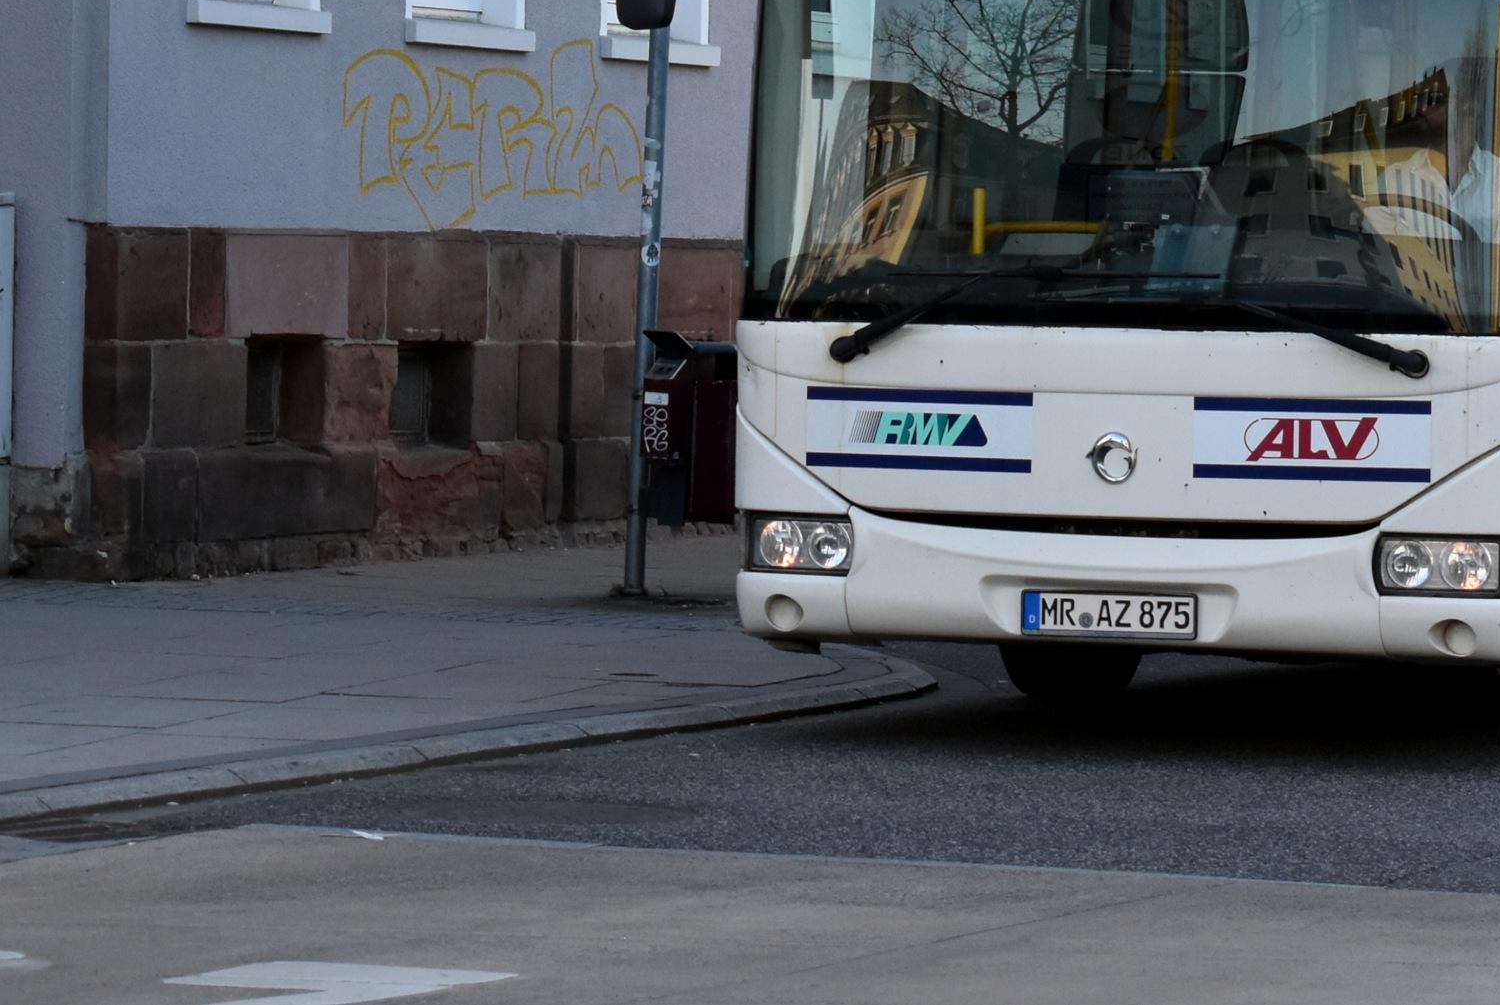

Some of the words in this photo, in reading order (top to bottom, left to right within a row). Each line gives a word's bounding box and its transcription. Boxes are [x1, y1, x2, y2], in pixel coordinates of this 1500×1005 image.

[874, 410, 978, 447] RMV
[1245, 417, 1379, 462] ALV
[1041, 598, 1076, 626] MR
[1097, 599, 1131, 628] AZ
[1139, 600, 1190, 629] 875
